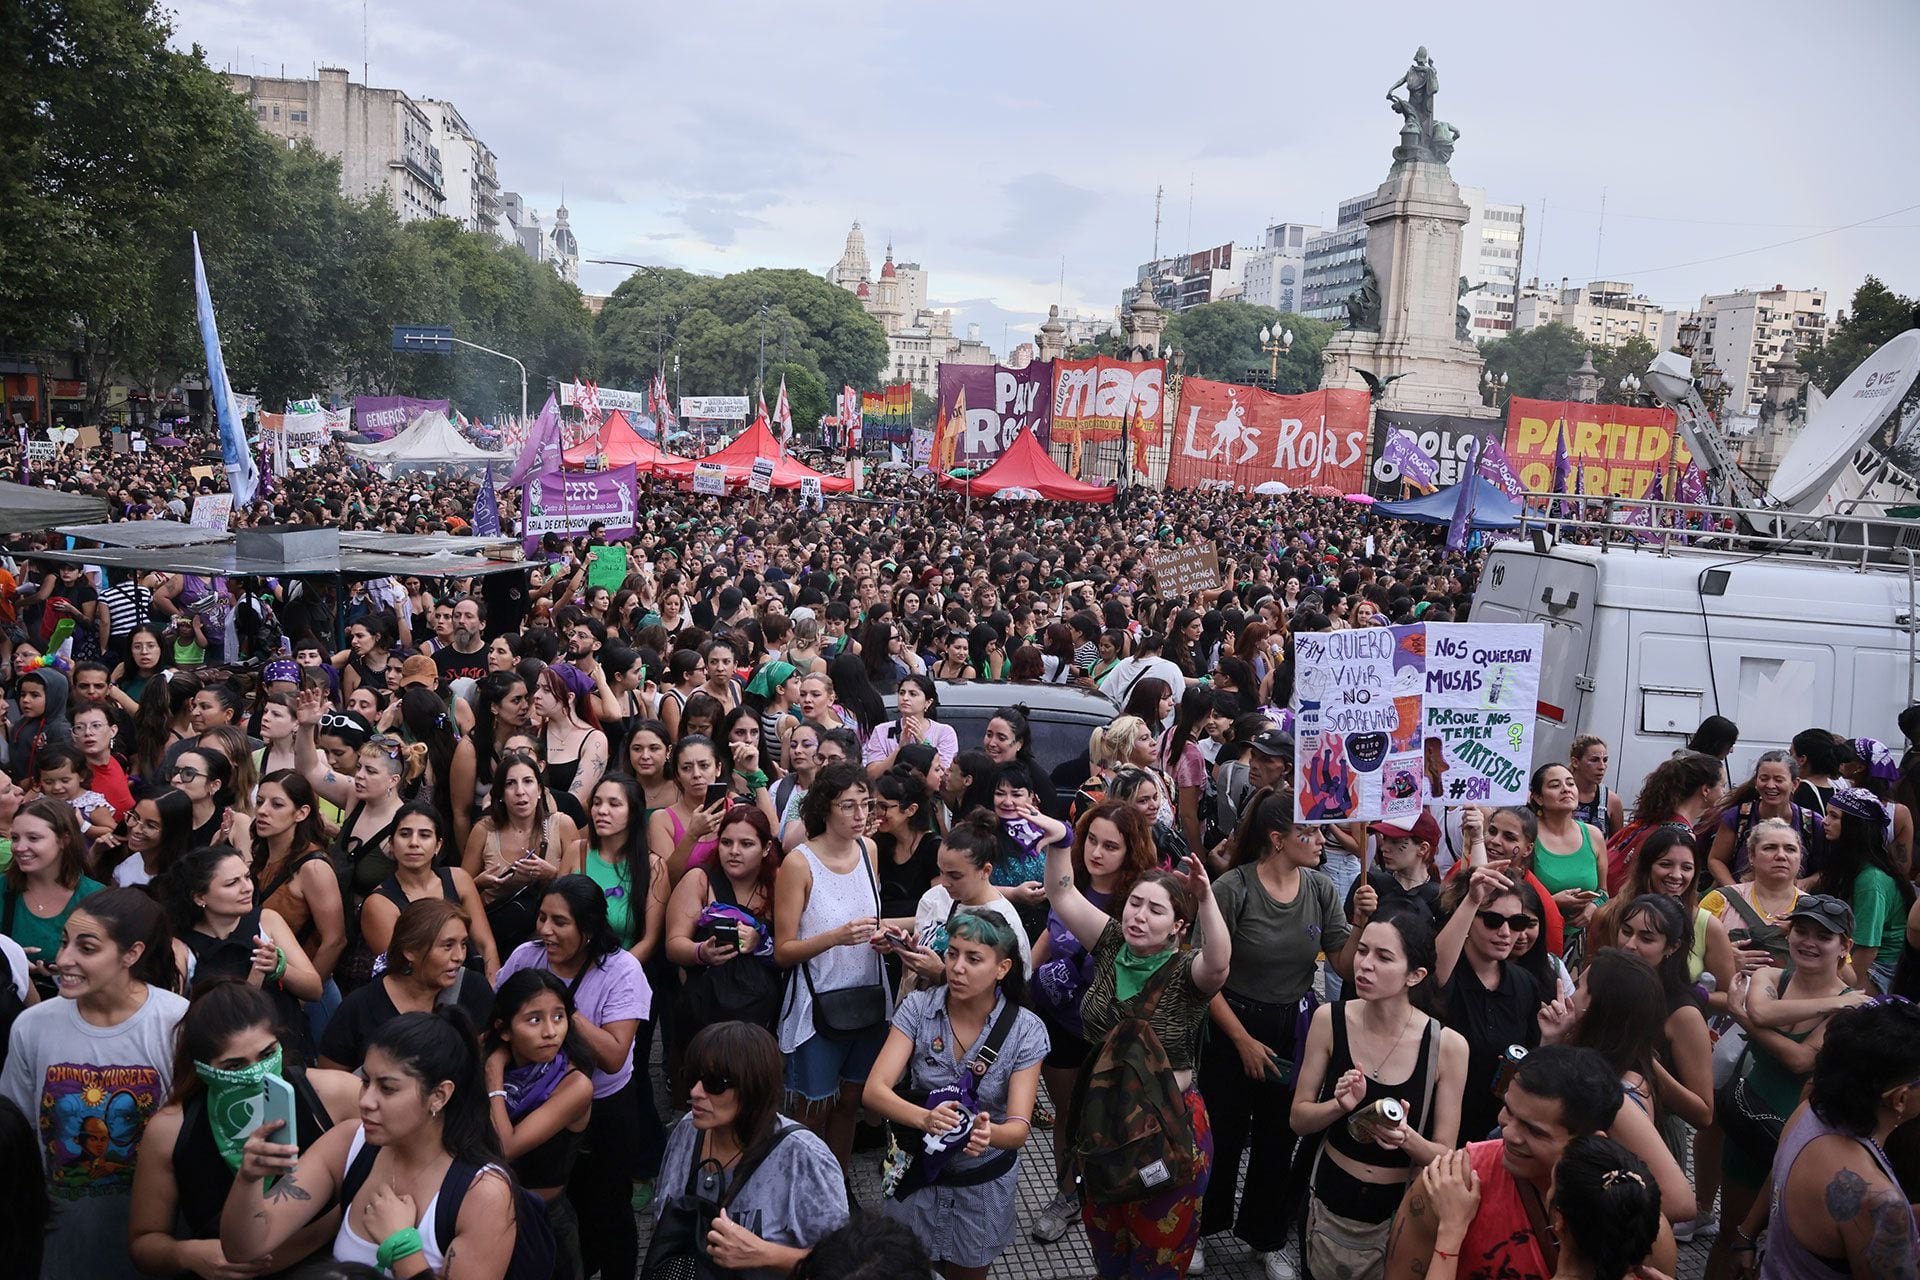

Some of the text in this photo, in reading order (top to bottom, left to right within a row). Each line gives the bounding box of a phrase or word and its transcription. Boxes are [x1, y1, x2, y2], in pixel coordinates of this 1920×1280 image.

[1060, 366, 1162, 419] mas
[1435, 638, 1468, 659] NOS
[1425, 669, 1482, 694] MUSAS
[1428, 708, 1512, 727] PORQUE NOS
[1441, 725, 1492, 742] TEMEN
[1449, 776, 1492, 801] #8M
[47, 1067, 158, 1086] CHANGE YOURSELF
